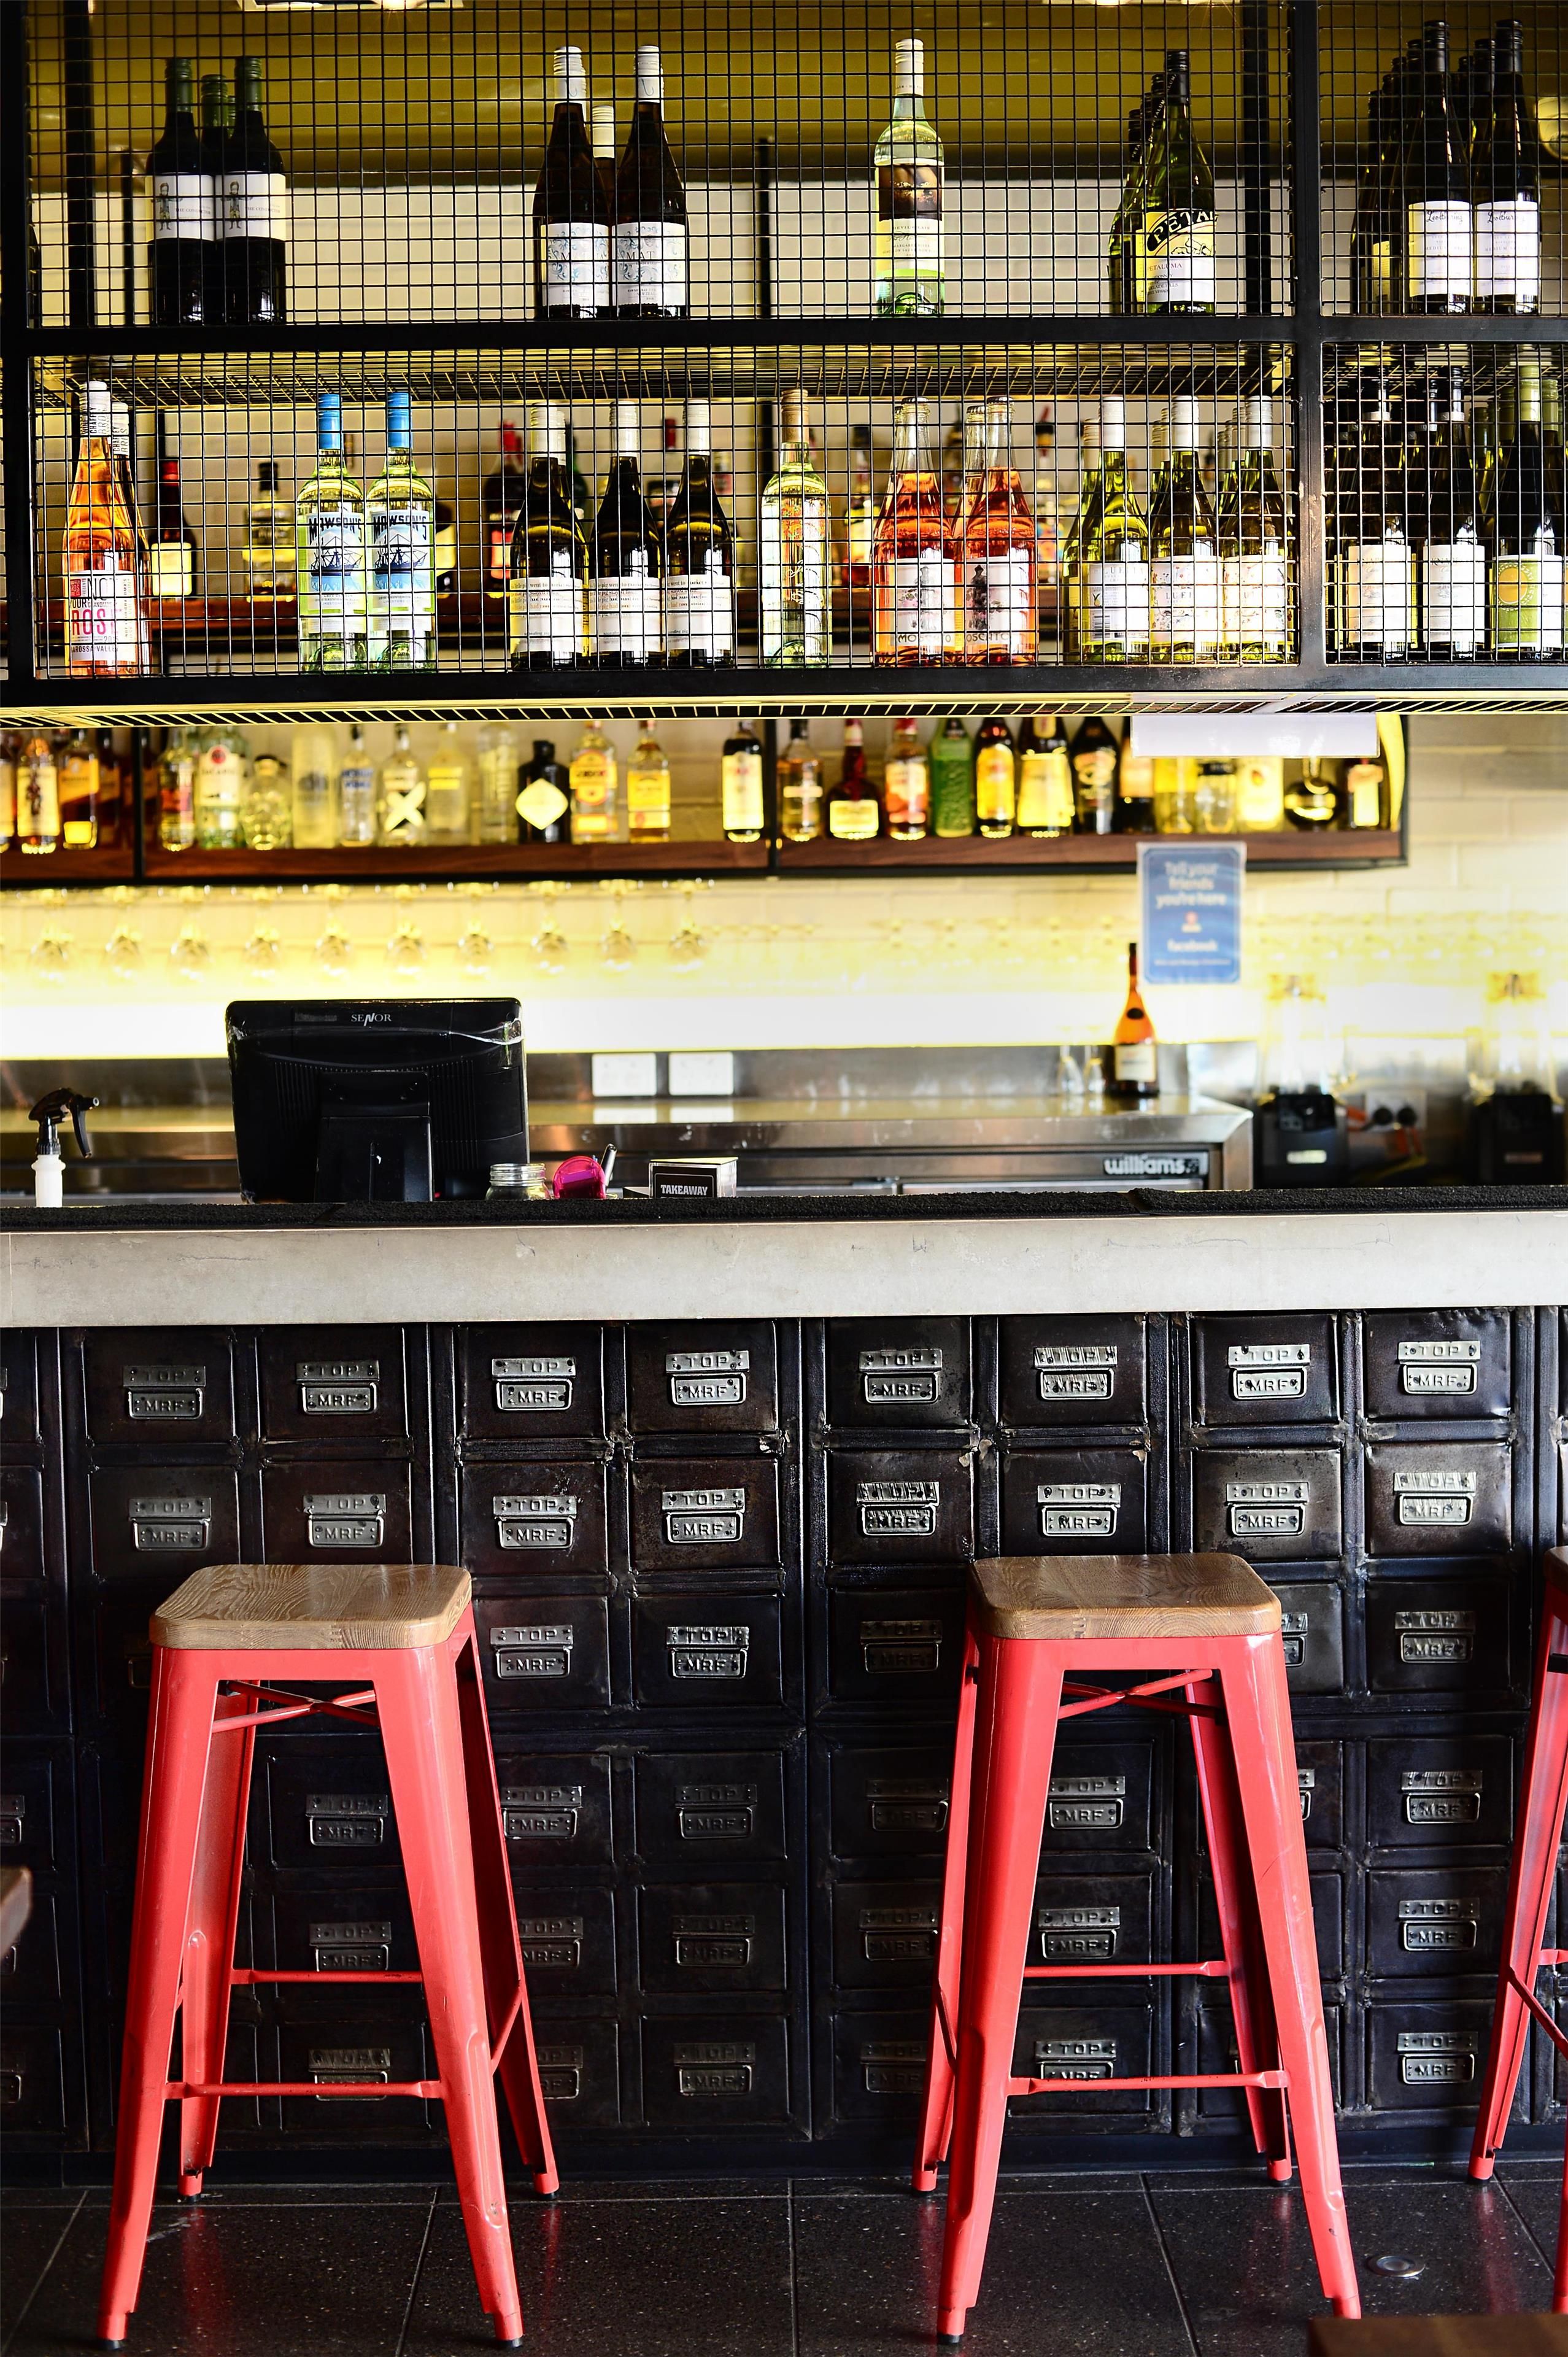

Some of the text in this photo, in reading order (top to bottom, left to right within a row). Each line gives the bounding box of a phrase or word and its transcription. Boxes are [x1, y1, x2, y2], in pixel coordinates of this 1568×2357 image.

[351, 1013, 392, 1026] SENOR
[660, 1185, 708, 1195] TAKEAWAY
[1248, 1350, 1289, 1361] TOP
[1419, 1346, 1459, 1357] TOP
[686, 1356, 728, 1367] TOP
[1249, 1379, 1288, 1391] MRF
[1418, 1374, 1458, 1386] MRF
[688, 1386, 727, 1398] MRF
[881, 1383, 921, 1395] MRF
[319, 1395, 357, 1406] MRF
[518, 1390, 558, 1403] MRF
[145, 1400, 183, 1412] MRF
[1057, 1487, 1100, 1498] TOP
[1247, 1487, 1288, 1497] TOP
[682, 1493, 725, 1505] TOP
[517, 1500, 558, 1511] TOP
[1248, 1515, 1288, 1527] MRF
[325, 1528, 364, 1539] MRF
[684, 1522, 724, 1535] MRF
[151, 1531, 190, 1542] MRF
[517, 1529, 557, 1541] MRF
[515, 1630, 557, 1641] TOP
[686, 1631, 728, 1642] TOP
[516, 1658, 555, 1671] MRF
[687, 1658, 726, 1671] MRF
[1064, 1809, 1104, 1821] MRF
[520, 1819, 558, 1831] MRF
[1418, 1931, 1458, 1943] MRF
[1060, 2044, 1102, 2054] TOP
[1418, 2064, 1456, 2076] MRF
